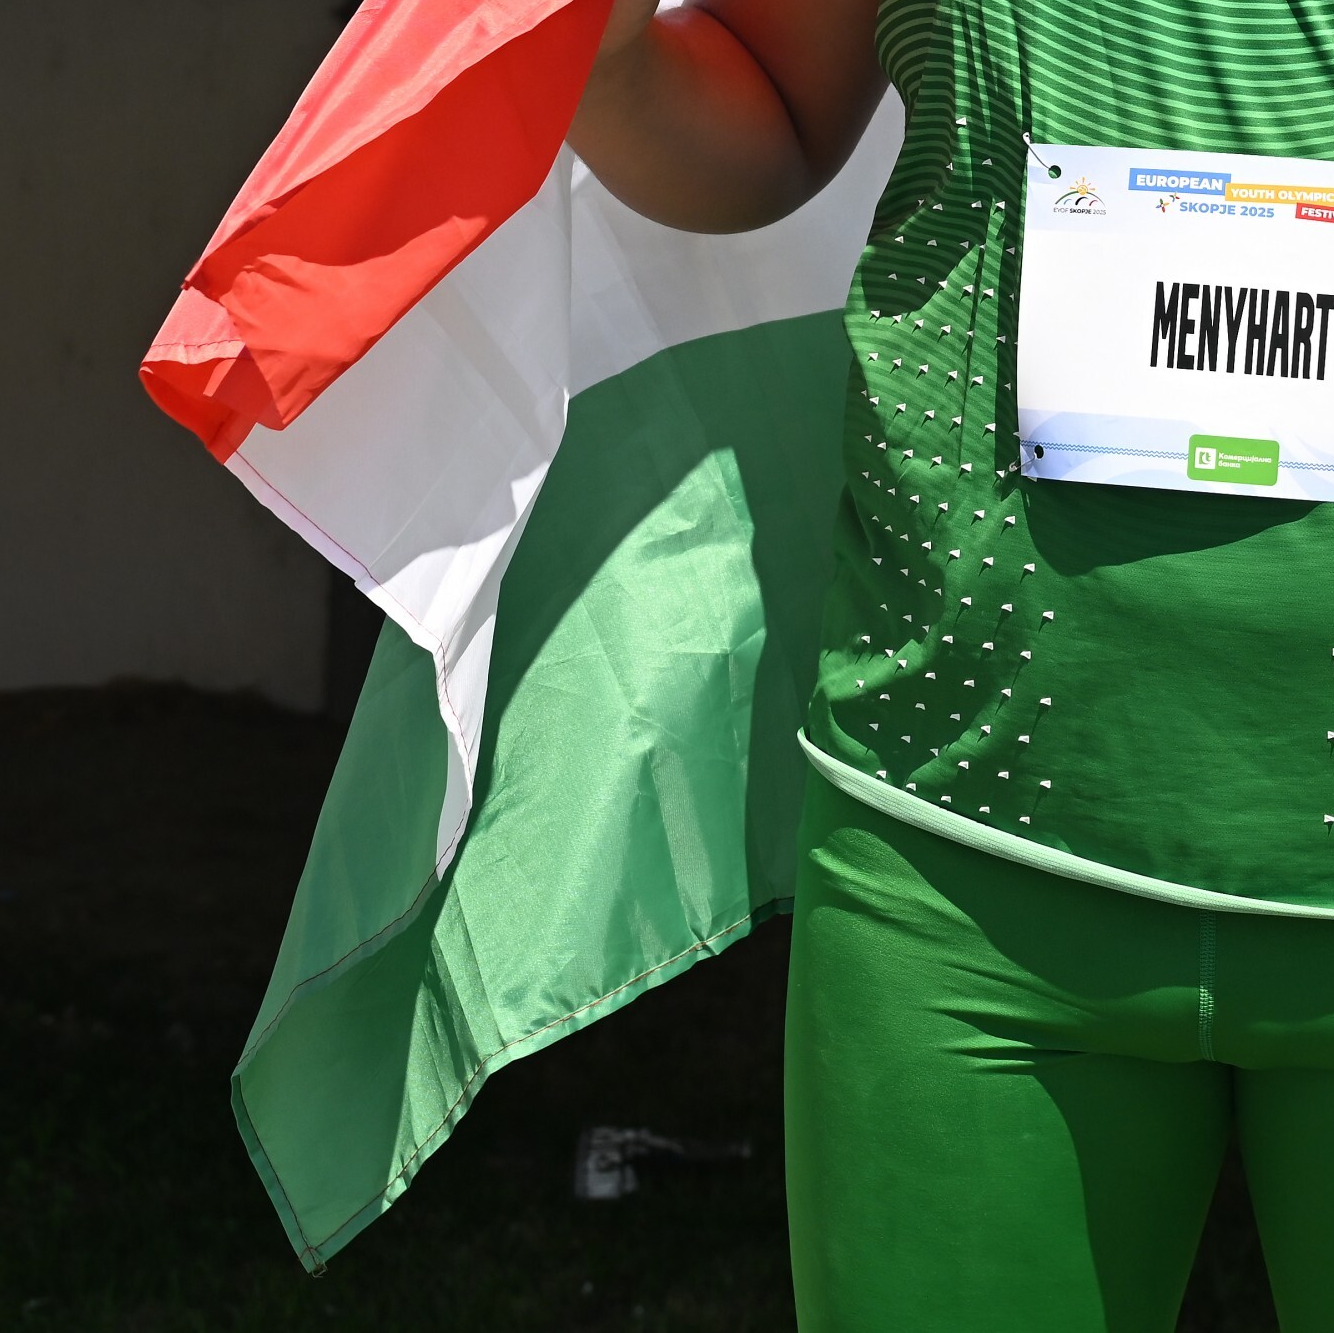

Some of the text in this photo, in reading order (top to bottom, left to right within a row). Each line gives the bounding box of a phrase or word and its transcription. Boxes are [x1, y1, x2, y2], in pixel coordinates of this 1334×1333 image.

[1136, 174, 1223, 191] EUROPEAN
[1231, 188, 1275, 200] YOUTH
[1179, 202, 1275, 218] SKOPJE 2025
